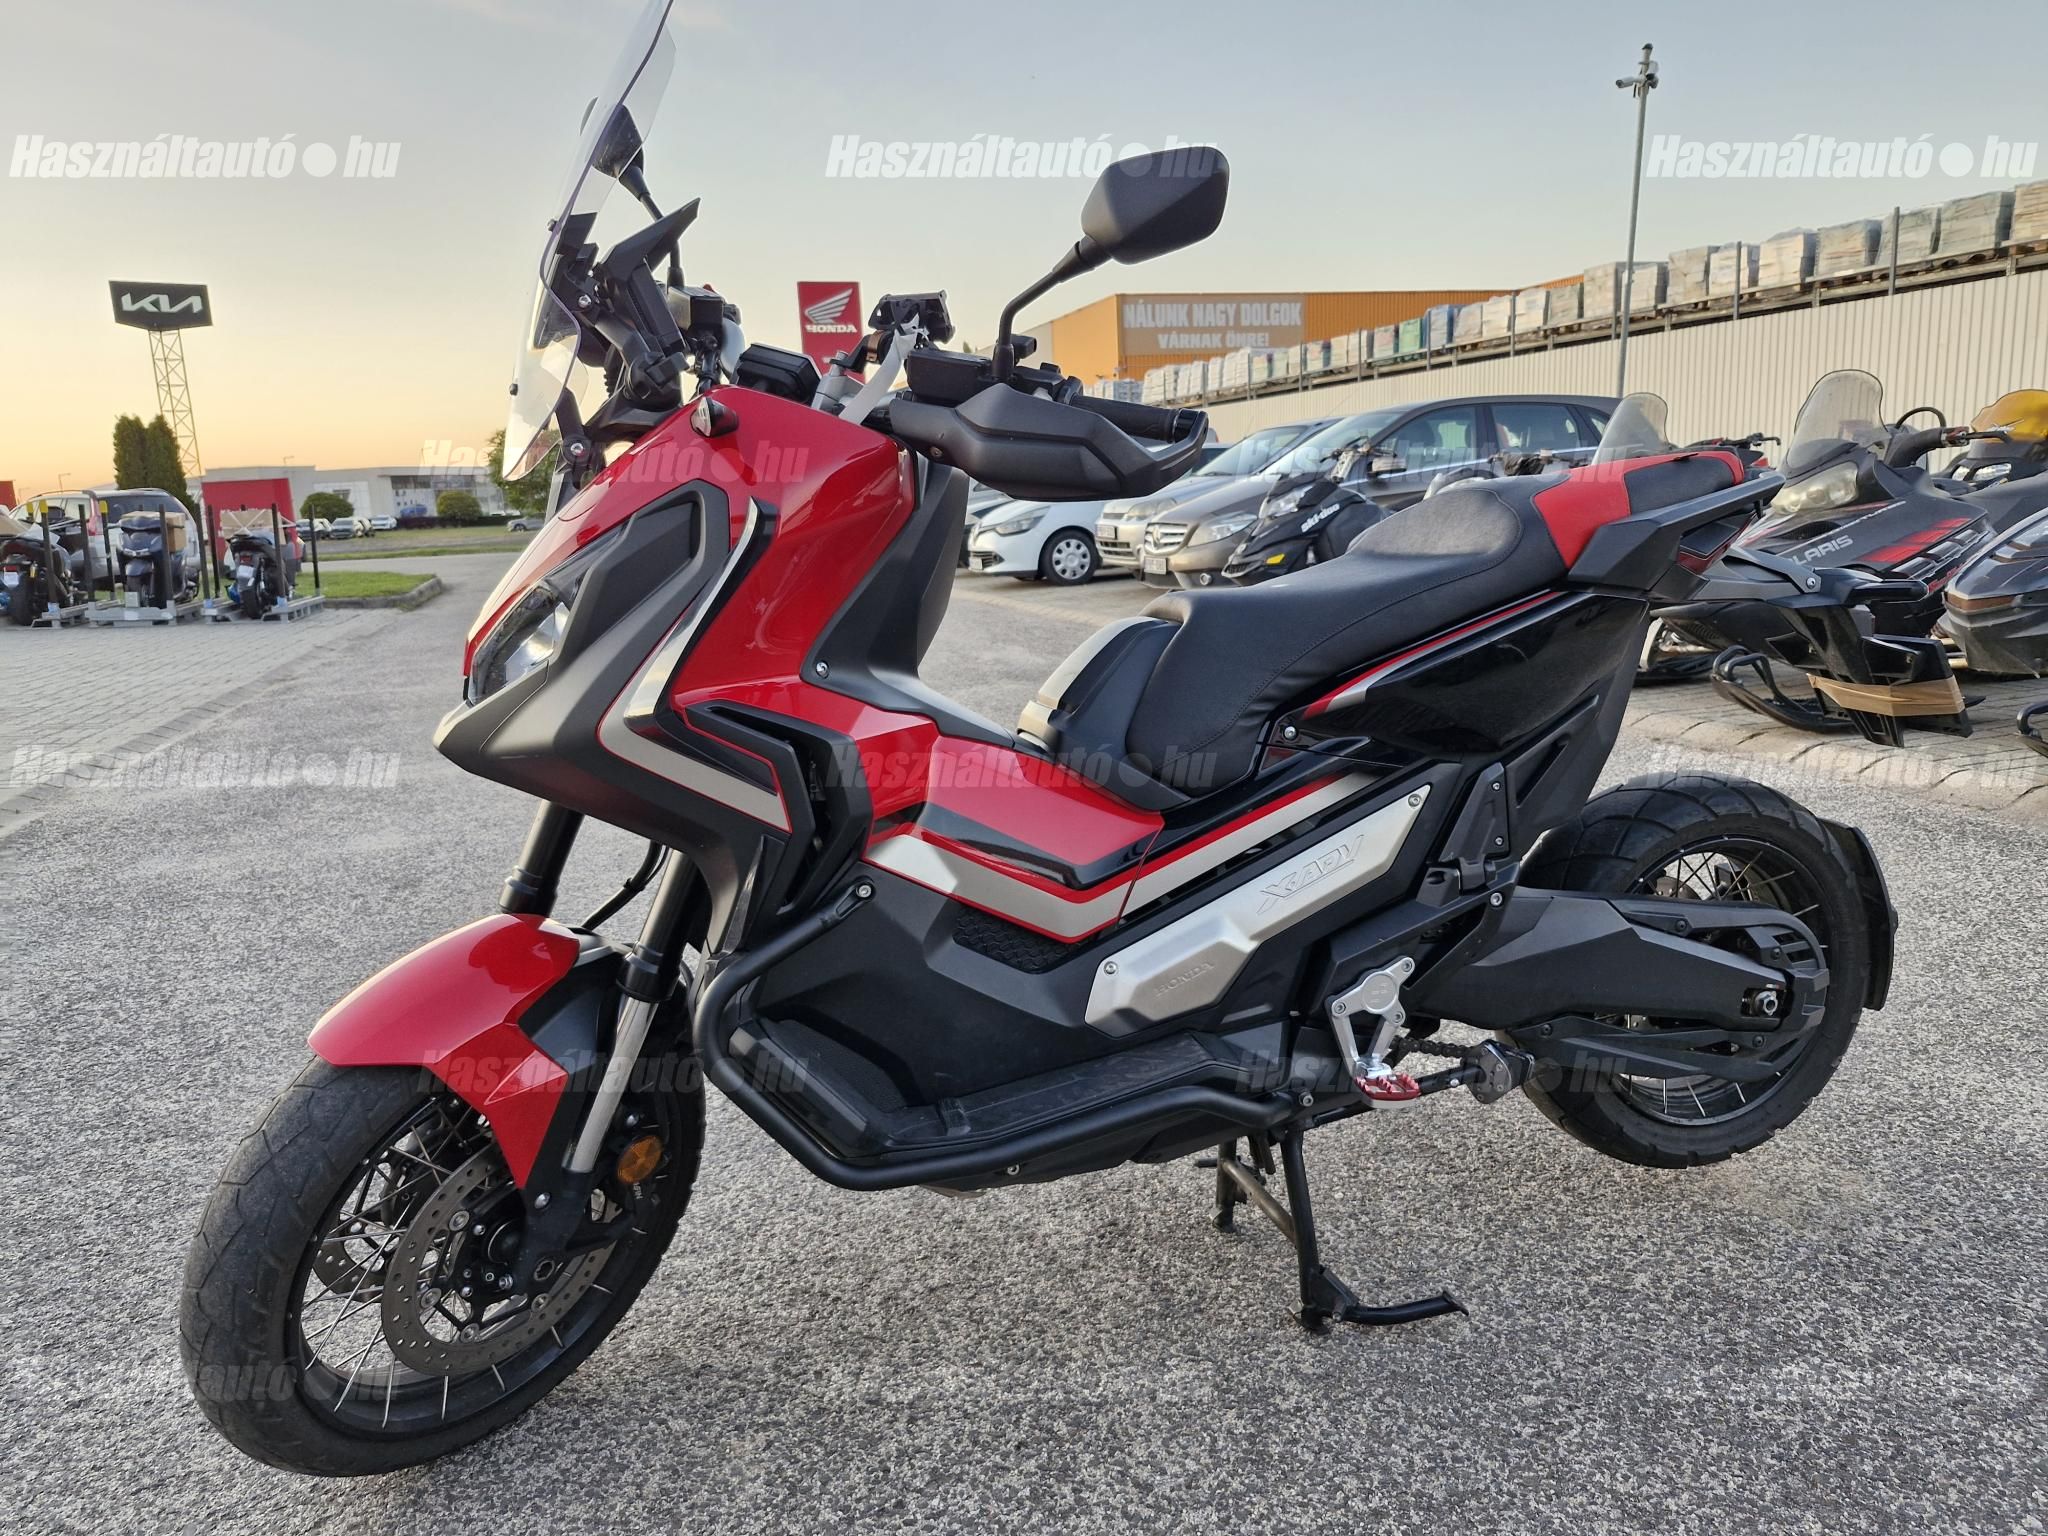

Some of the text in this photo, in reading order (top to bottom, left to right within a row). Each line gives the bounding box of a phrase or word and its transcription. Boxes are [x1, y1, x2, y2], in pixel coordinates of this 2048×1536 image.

[1123, 299, 1303, 328] NÁLUNK NAGY DOLGOK
[804, 324, 858, 334] HONDA
[1157, 330, 1222, 349] VÁRNAK
[1790, 534, 1854, 566] LARIS
[1153, 963, 1215, 998] HONDA
